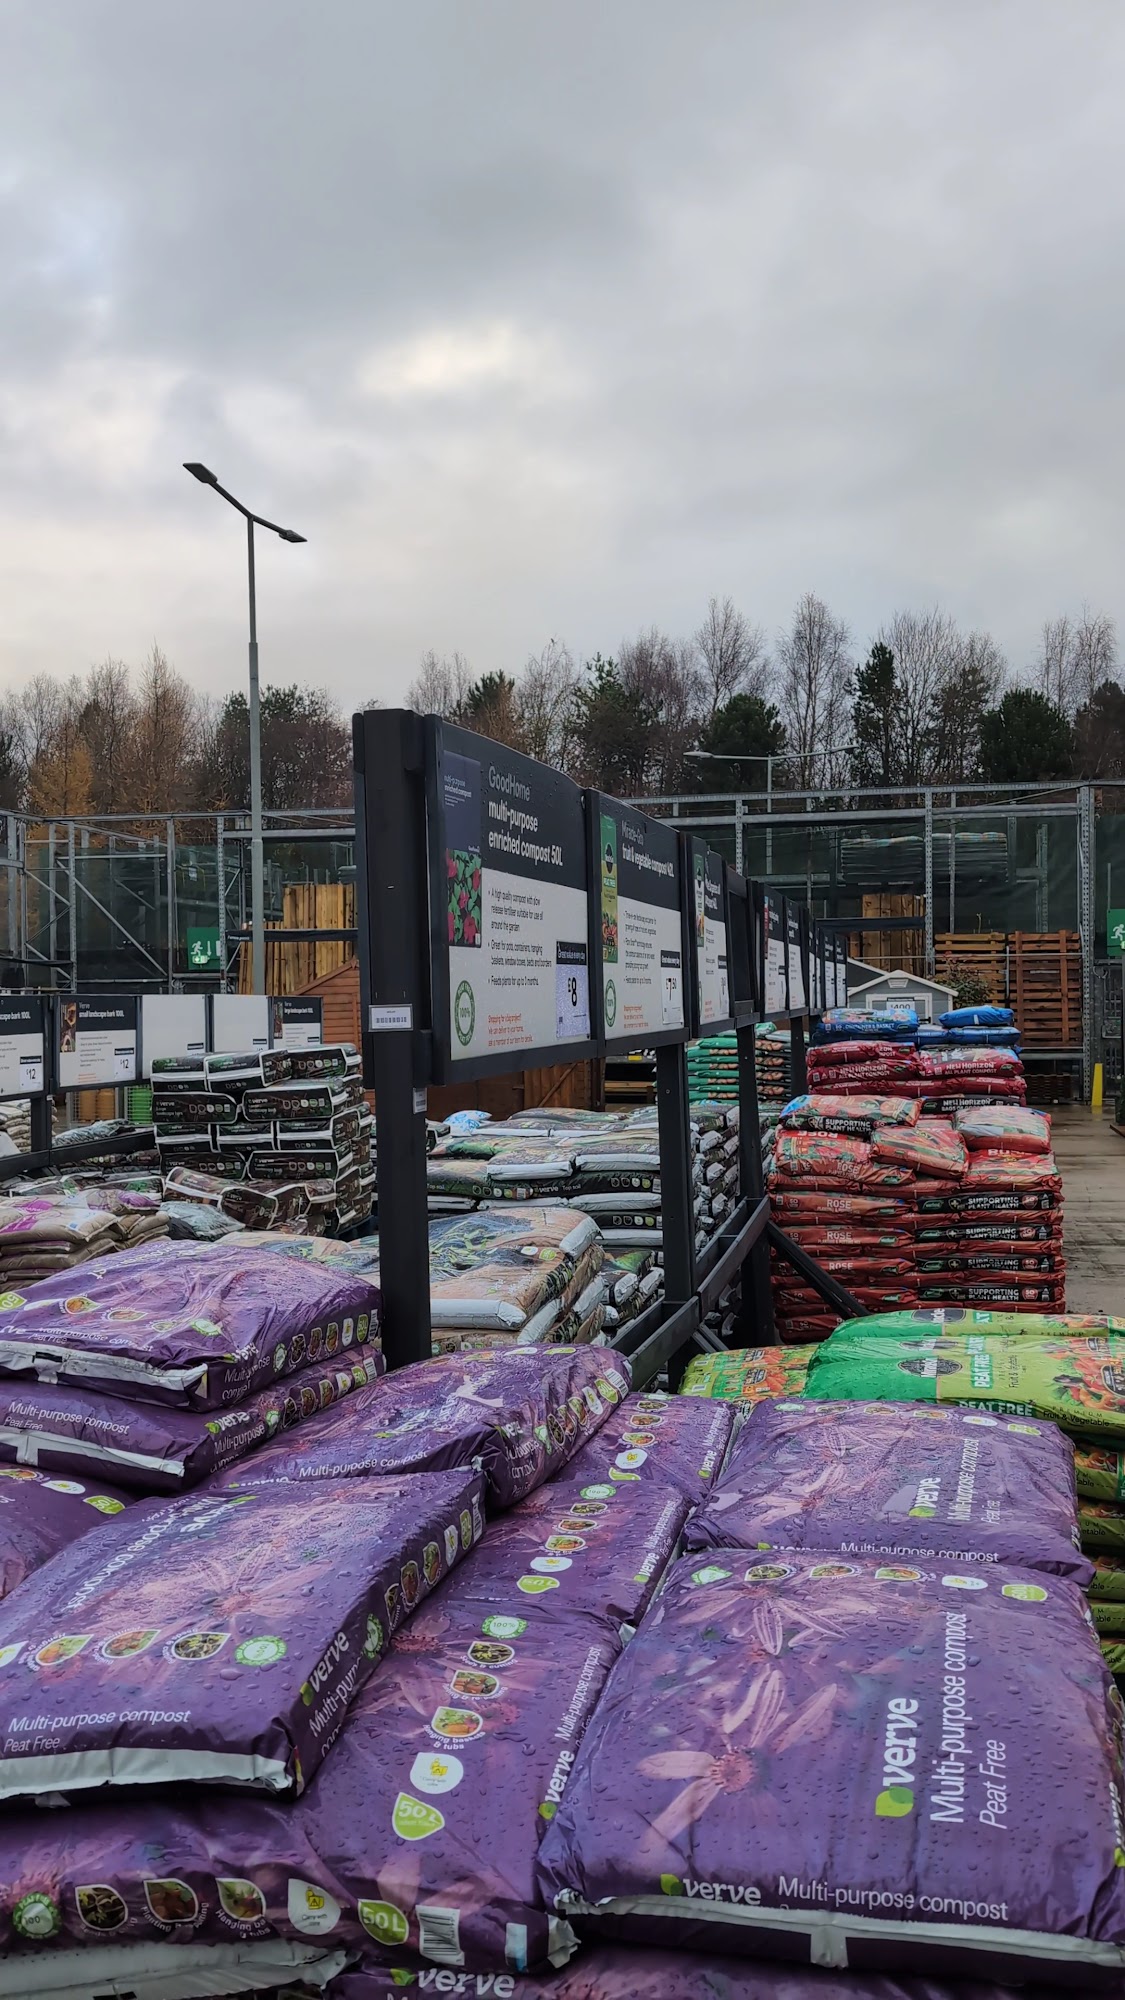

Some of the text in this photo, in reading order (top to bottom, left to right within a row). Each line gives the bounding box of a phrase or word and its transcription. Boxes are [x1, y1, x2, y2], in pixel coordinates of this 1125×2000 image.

[488, 766, 531, 801] GoodHome
[488, 800, 538, 833] multi-purpose
[488, 829, 563, 866] enriched compost 50L
[0, 1013, 11, 1022] scape
[79, 1010, 89, 1018] small
[89, 1010, 106, 1019] landscape
[962, 1061, 996, 1069] HORIZON
[960, 1098, 993, 1106] HORIZON
[825, 1118, 871, 1128] SUPPORTING
[826, 1199, 852, 1209] ROSE
[968, 1197, 1019, 1205] SUPPORTING
[826, 1231, 852, 1240] ROSE
[829, 1262, 853, 1271] ROSE
[967, 1258, 1019, 1266] SUPPORTING
[968, 1288, 1019, 1296] SUPPORTING
[974, 1354, 990, 1370] FREE
[974, 1371, 990, 1387] PEAT
[959, 1400, 1033, 1417] PEAT FREE
[1052, 1406, 1103, 1418] PREMIUM
[3, 1416, 23, 1429] Peat
[9, 1400, 130, 1435] Multi-purpose compost
[1043, 1410, 1110, 1427] Fruit & Vegetable
[214, 1423, 266, 1454] Multi-purpose
[961, 1438, 982, 1472] compost
[299, 1450, 428, 1478] Multi-purpose compost
[914, 1477, 941, 1508] verve
[1081, 1528, 1106, 1537] etable
[841, 1541, 999, 1562] Multi-purpose compost
[638, 1552, 660, 1577] verve
[309, 1631, 350, 1693] verve
[7, 1709, 193, 1734] Multi-purpose compost
[545, 1646, 602, 1803] verve Multi-purpose compost
[930, 1612, 974, 1823] Multi-purpose compost
[4, 1735, 61, 1752] Peat Free
[452, 1731, 486, 1743] baskets
[883, 1697, 919, 1787] verve
[979, 1739, 1008, 1829] Peat Free
[682, 1875, 1009, 1922] verve Multi-purpose compost
[215, 1908, 252, 1931] Hanging
[417, 1968, 515, 1998] verve
